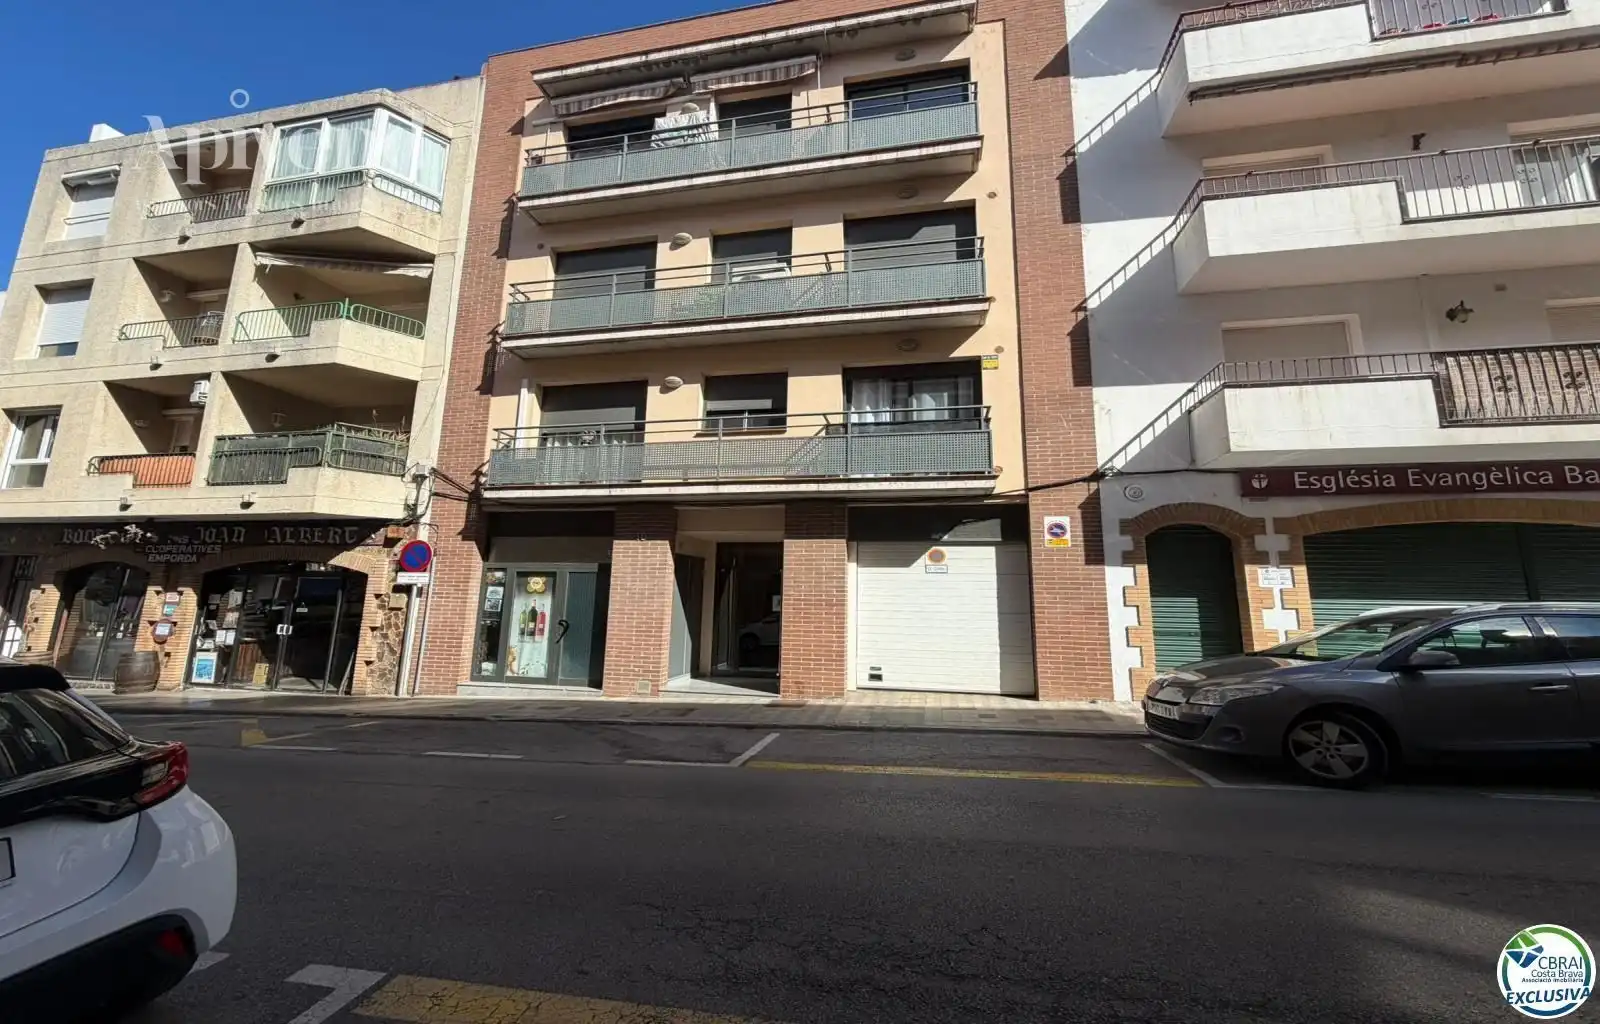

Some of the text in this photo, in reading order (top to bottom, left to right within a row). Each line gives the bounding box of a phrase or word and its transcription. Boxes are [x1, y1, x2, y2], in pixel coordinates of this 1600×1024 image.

[1294, 465, 1600, 493] Església Evangèlica Ba
[265, 526, 359, 545] ALBERT
